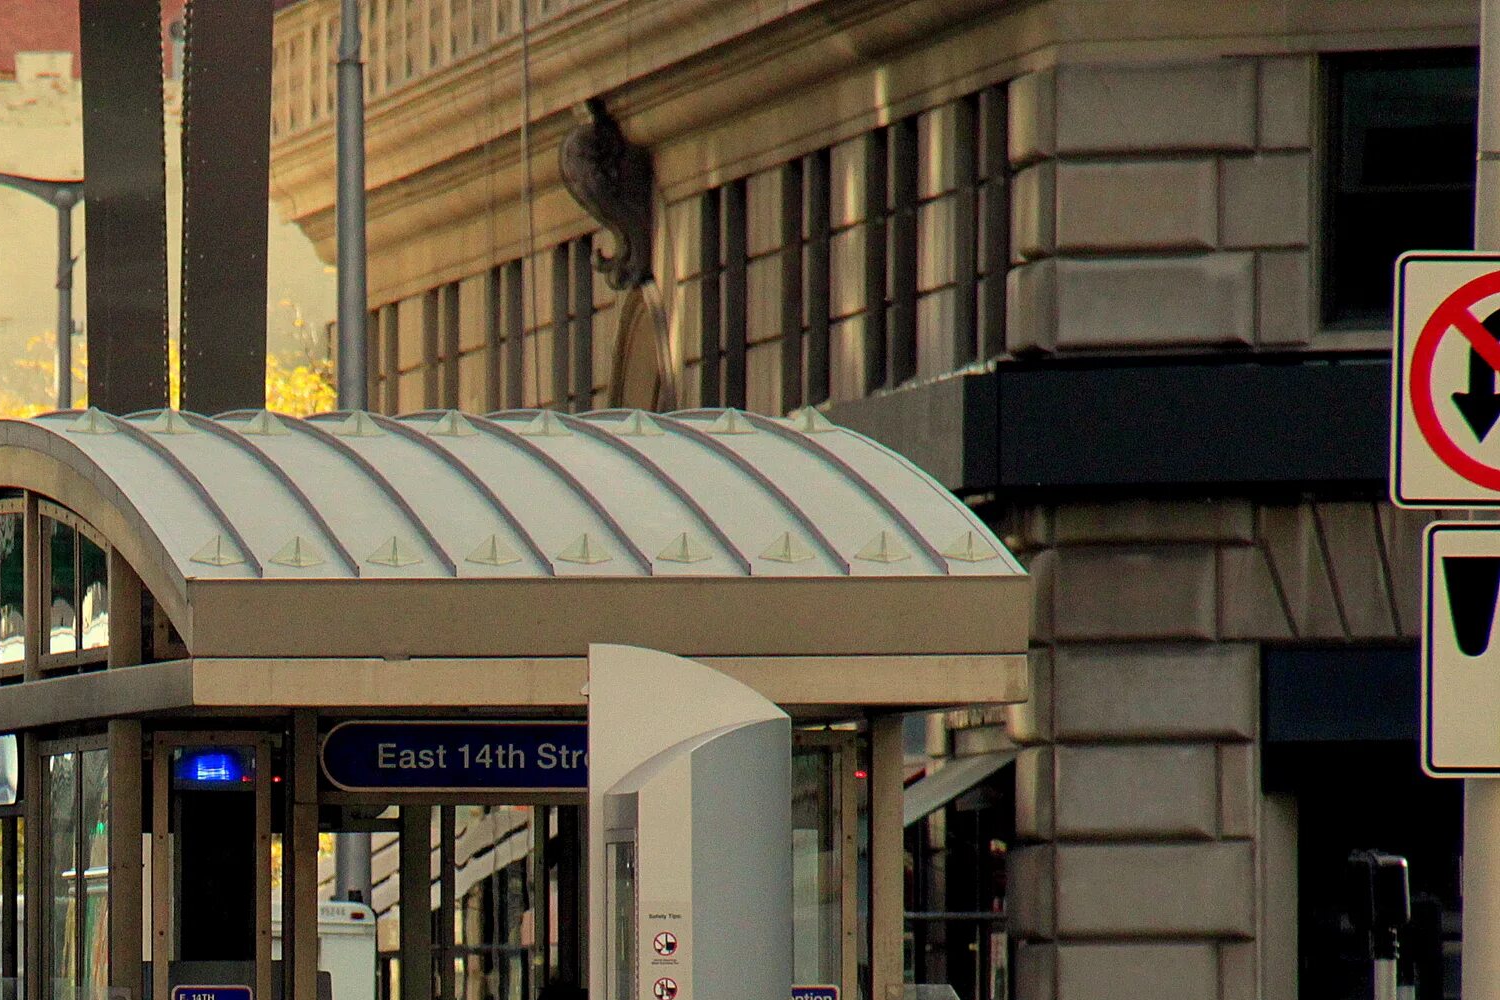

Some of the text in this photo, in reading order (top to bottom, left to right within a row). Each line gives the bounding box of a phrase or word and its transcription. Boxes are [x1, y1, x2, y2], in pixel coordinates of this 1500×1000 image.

[378, 743, 589, 769] East 14th Str
